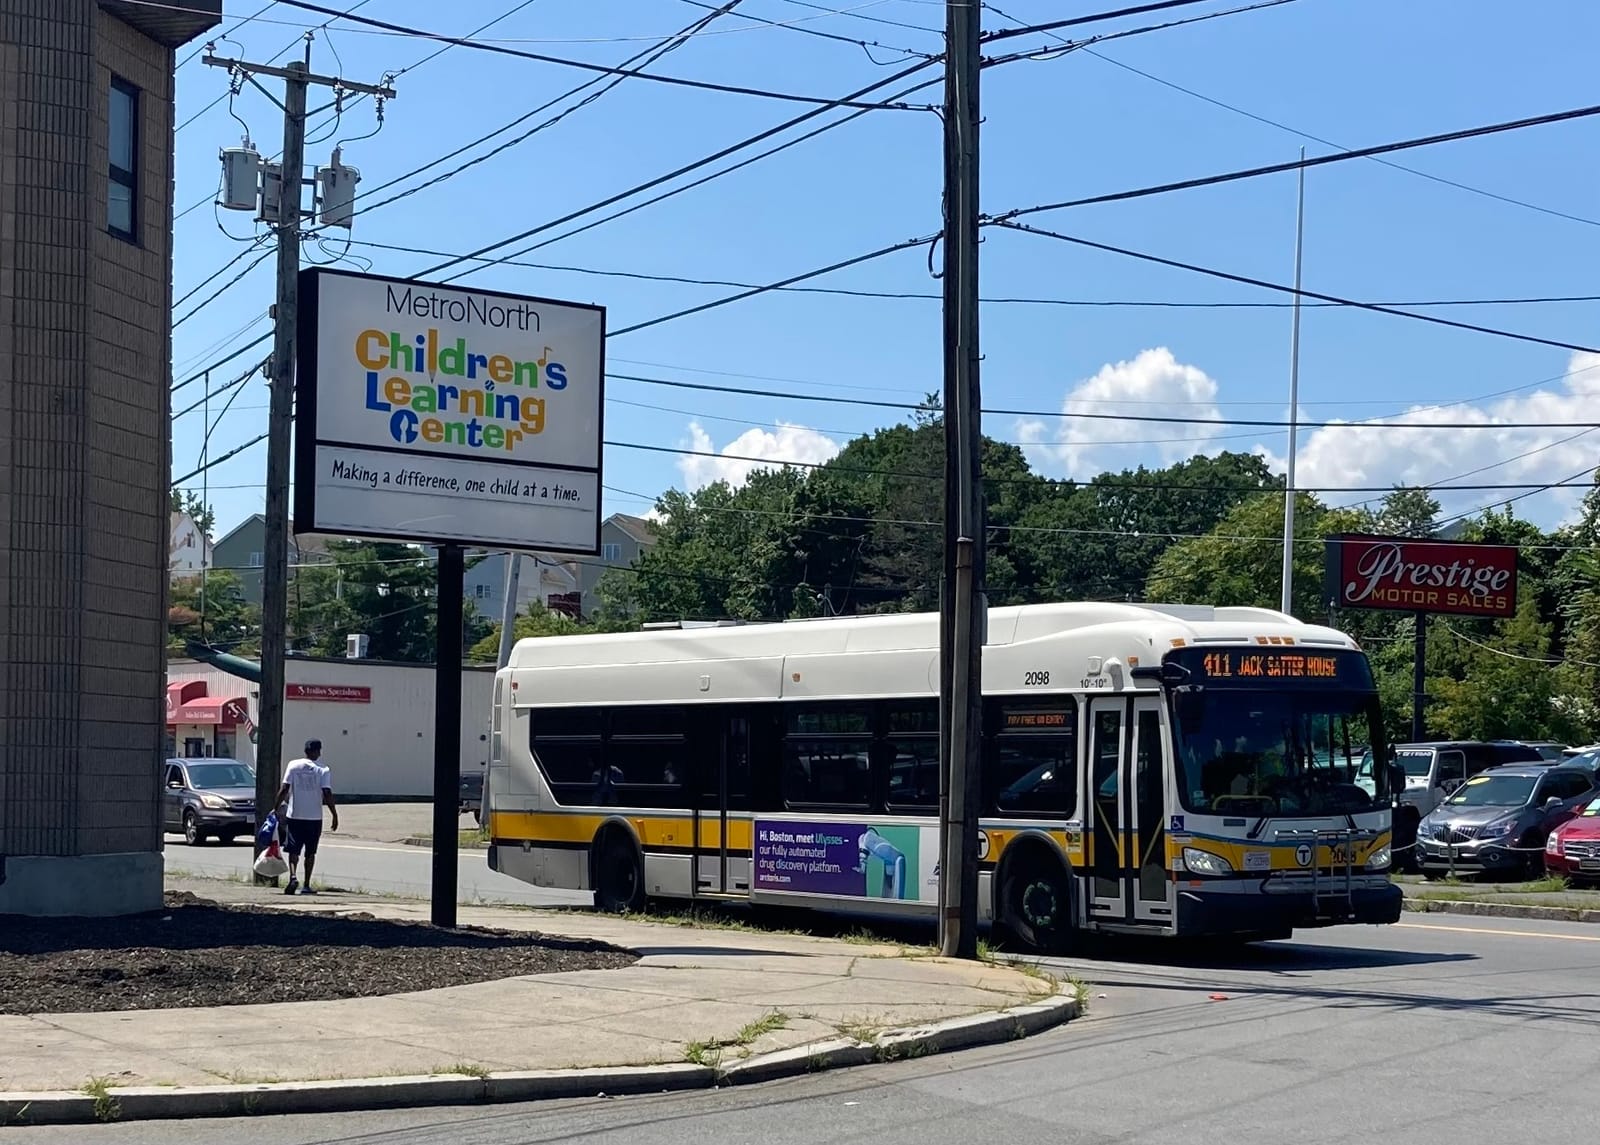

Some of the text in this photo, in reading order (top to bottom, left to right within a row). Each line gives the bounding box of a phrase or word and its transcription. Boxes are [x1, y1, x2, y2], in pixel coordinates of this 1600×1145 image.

[386, 284, 541, 332] MetroNorth
[355, 328, 568, 390] Children's
[365, 371, 546, 434] Learning
[389, 409, 524, 451] Center
[331, 459, 581, 502] Making a difference, one child at a time.
[1345, 543, 1510, 602] Prestige
[1371, 587, 1507, 610] MOTOR SALES
[1238, 655, 1264, 676] JACK
[1267, 656, 1304, 677] SATTER
[1307, 657, 1337, 677] HOUSE
[1025, 671, 1050, 686] 2098
[760, 830, 769, 842] Hi,
[770, 831, 795, 843] Boston,
[796, 833, 814, 843] meet
[815, 833, 843, 846] Ulysses
[760, 844, 826, 858] our fully automated
[1298, 849, 1309, 863] T
[760, 858, 842, 874] drug discovery platform.
